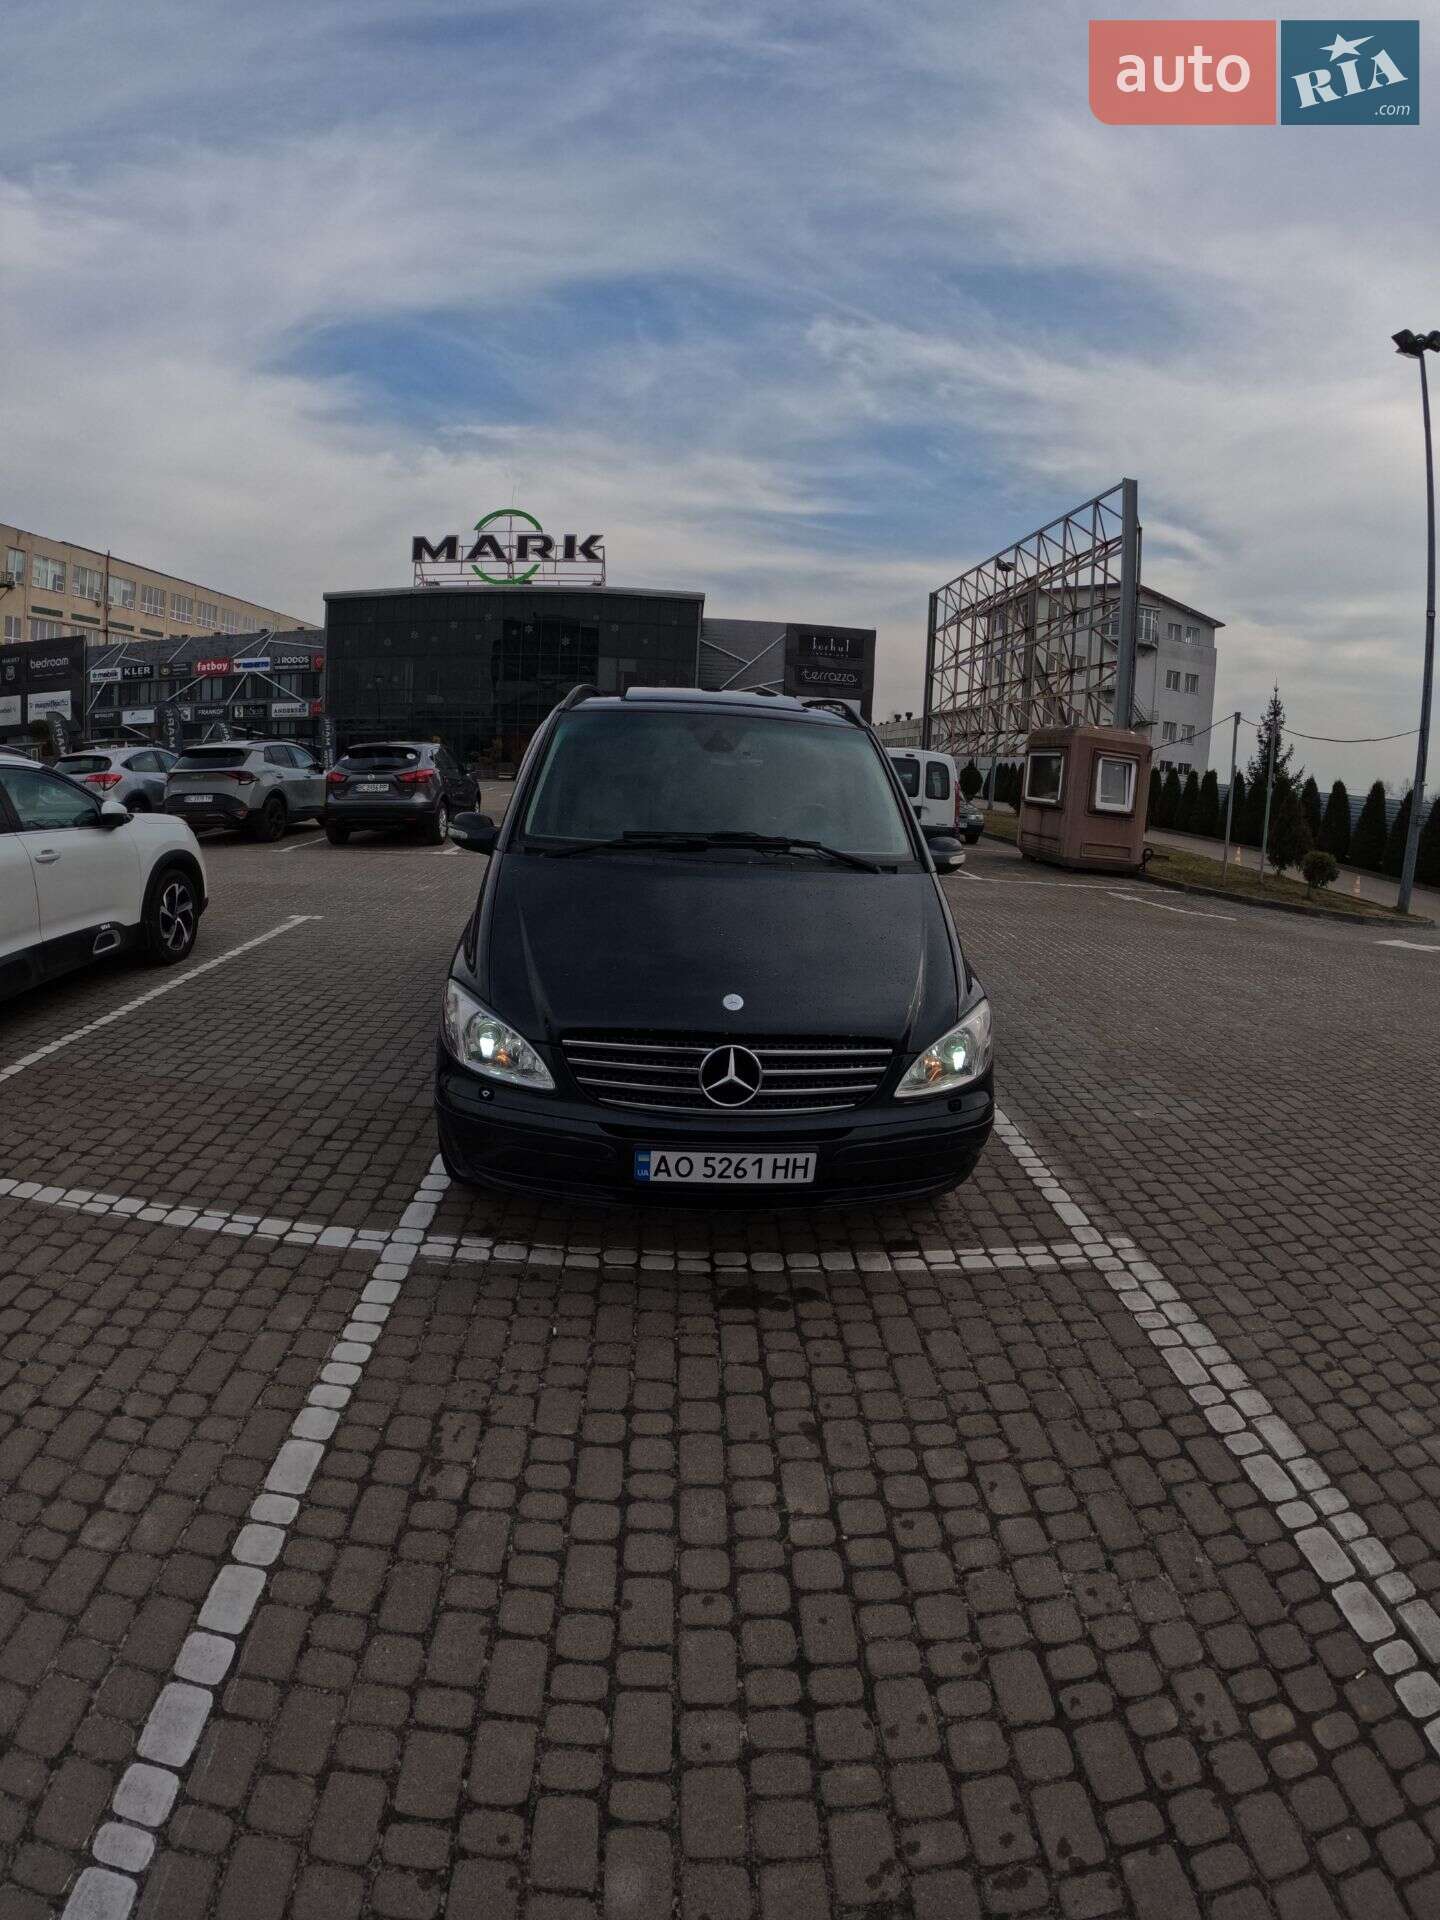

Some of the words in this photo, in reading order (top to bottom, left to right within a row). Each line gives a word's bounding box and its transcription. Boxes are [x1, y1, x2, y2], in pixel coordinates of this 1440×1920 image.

[412, 534, 604, 563] MARK
[30, 657, 69, 670] bedroom
[197, 661, 229, 672] fatboy
[124, 666, 151, 676] KLER
[637, 1169, 650, 1177] UA
[652, 1155, 694, 1178] AO
[702, 1156, 764, 1180] 5261
[771, 1157, 810, 1180] HH
